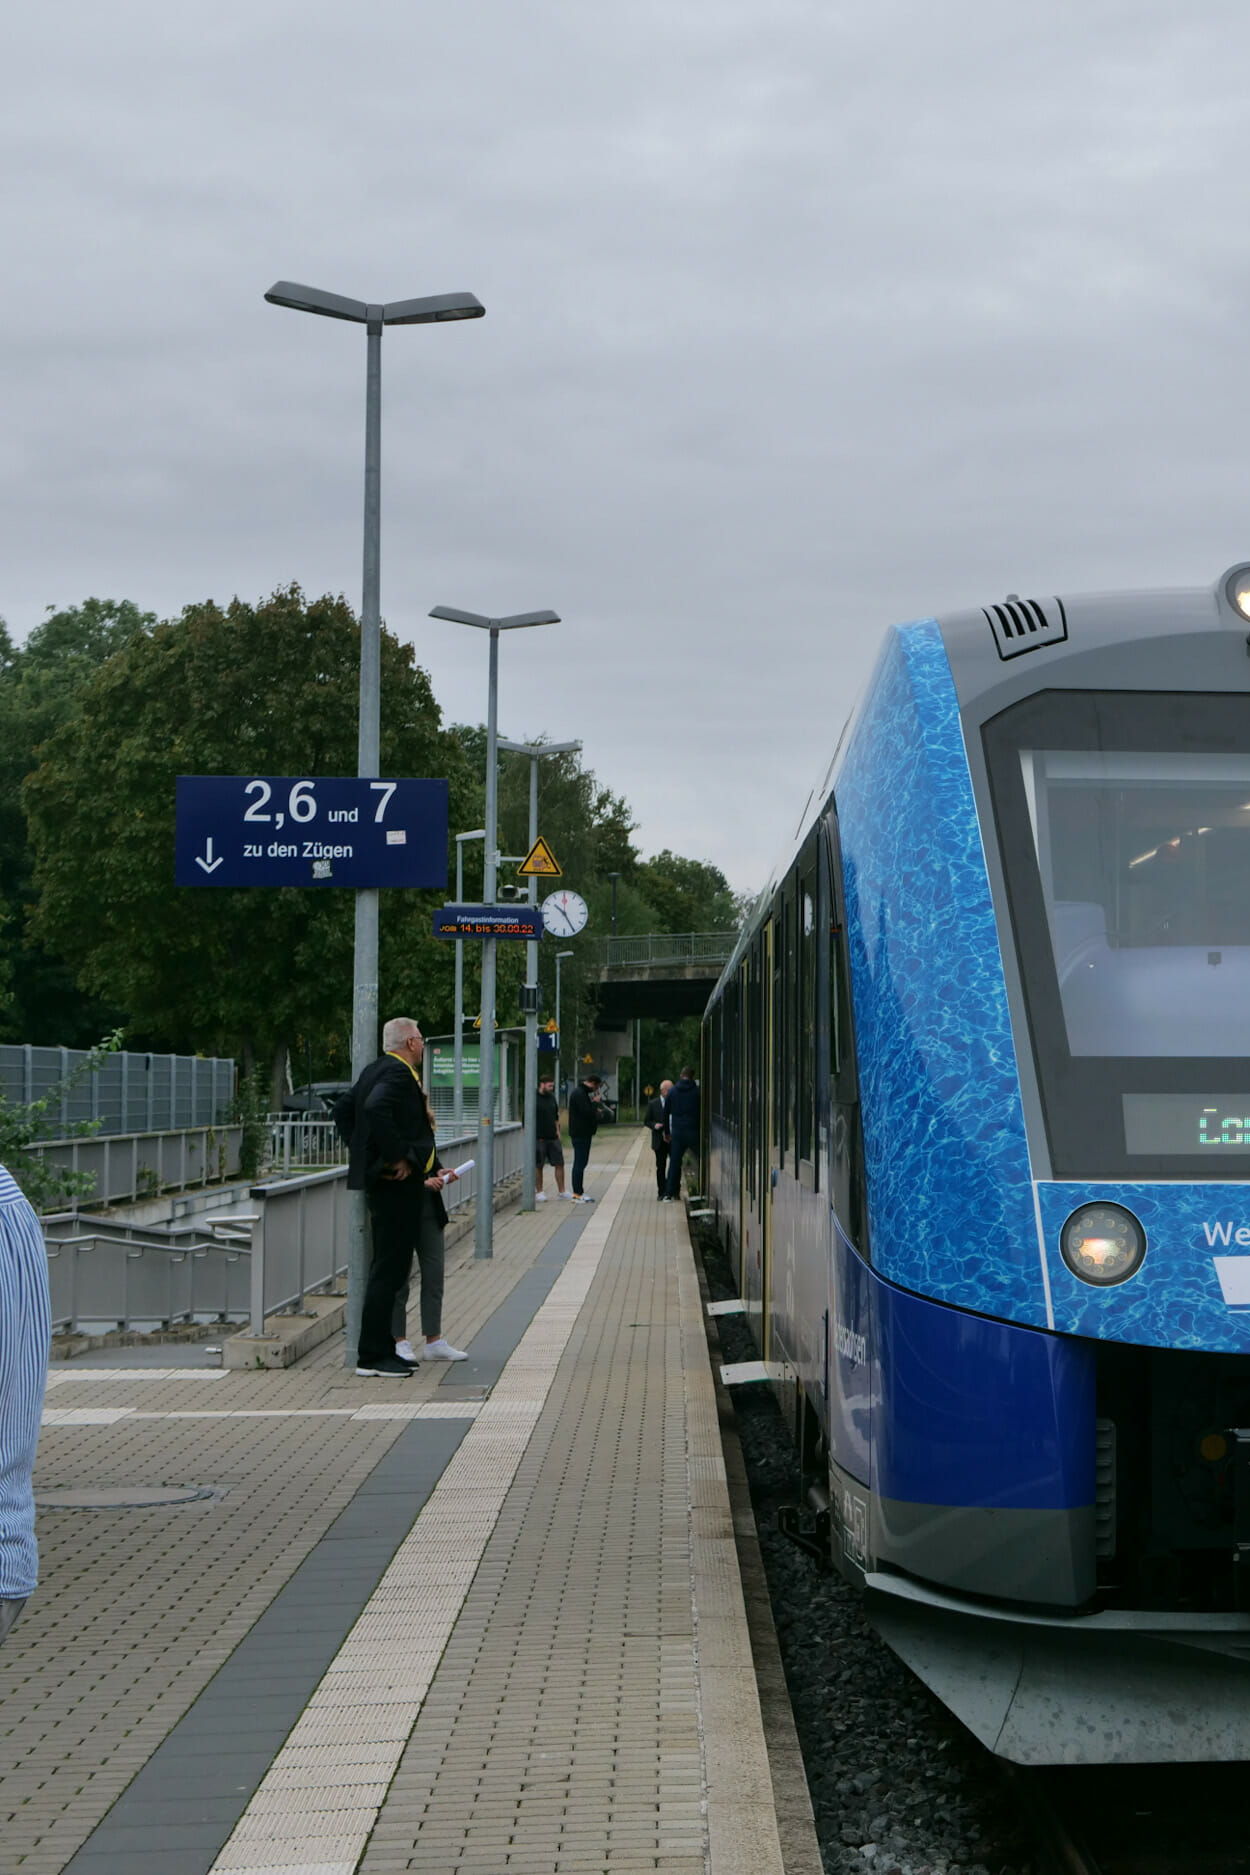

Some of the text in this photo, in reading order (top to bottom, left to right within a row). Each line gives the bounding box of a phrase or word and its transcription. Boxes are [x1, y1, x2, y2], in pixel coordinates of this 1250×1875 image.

[243, 779, 398, 830] 2,6 und 7
[243, 841, 353, 859] zu den Zügen
[456, 915, 519, 924] Fahrgastinformation
[475, 924, 491, 933] bis
